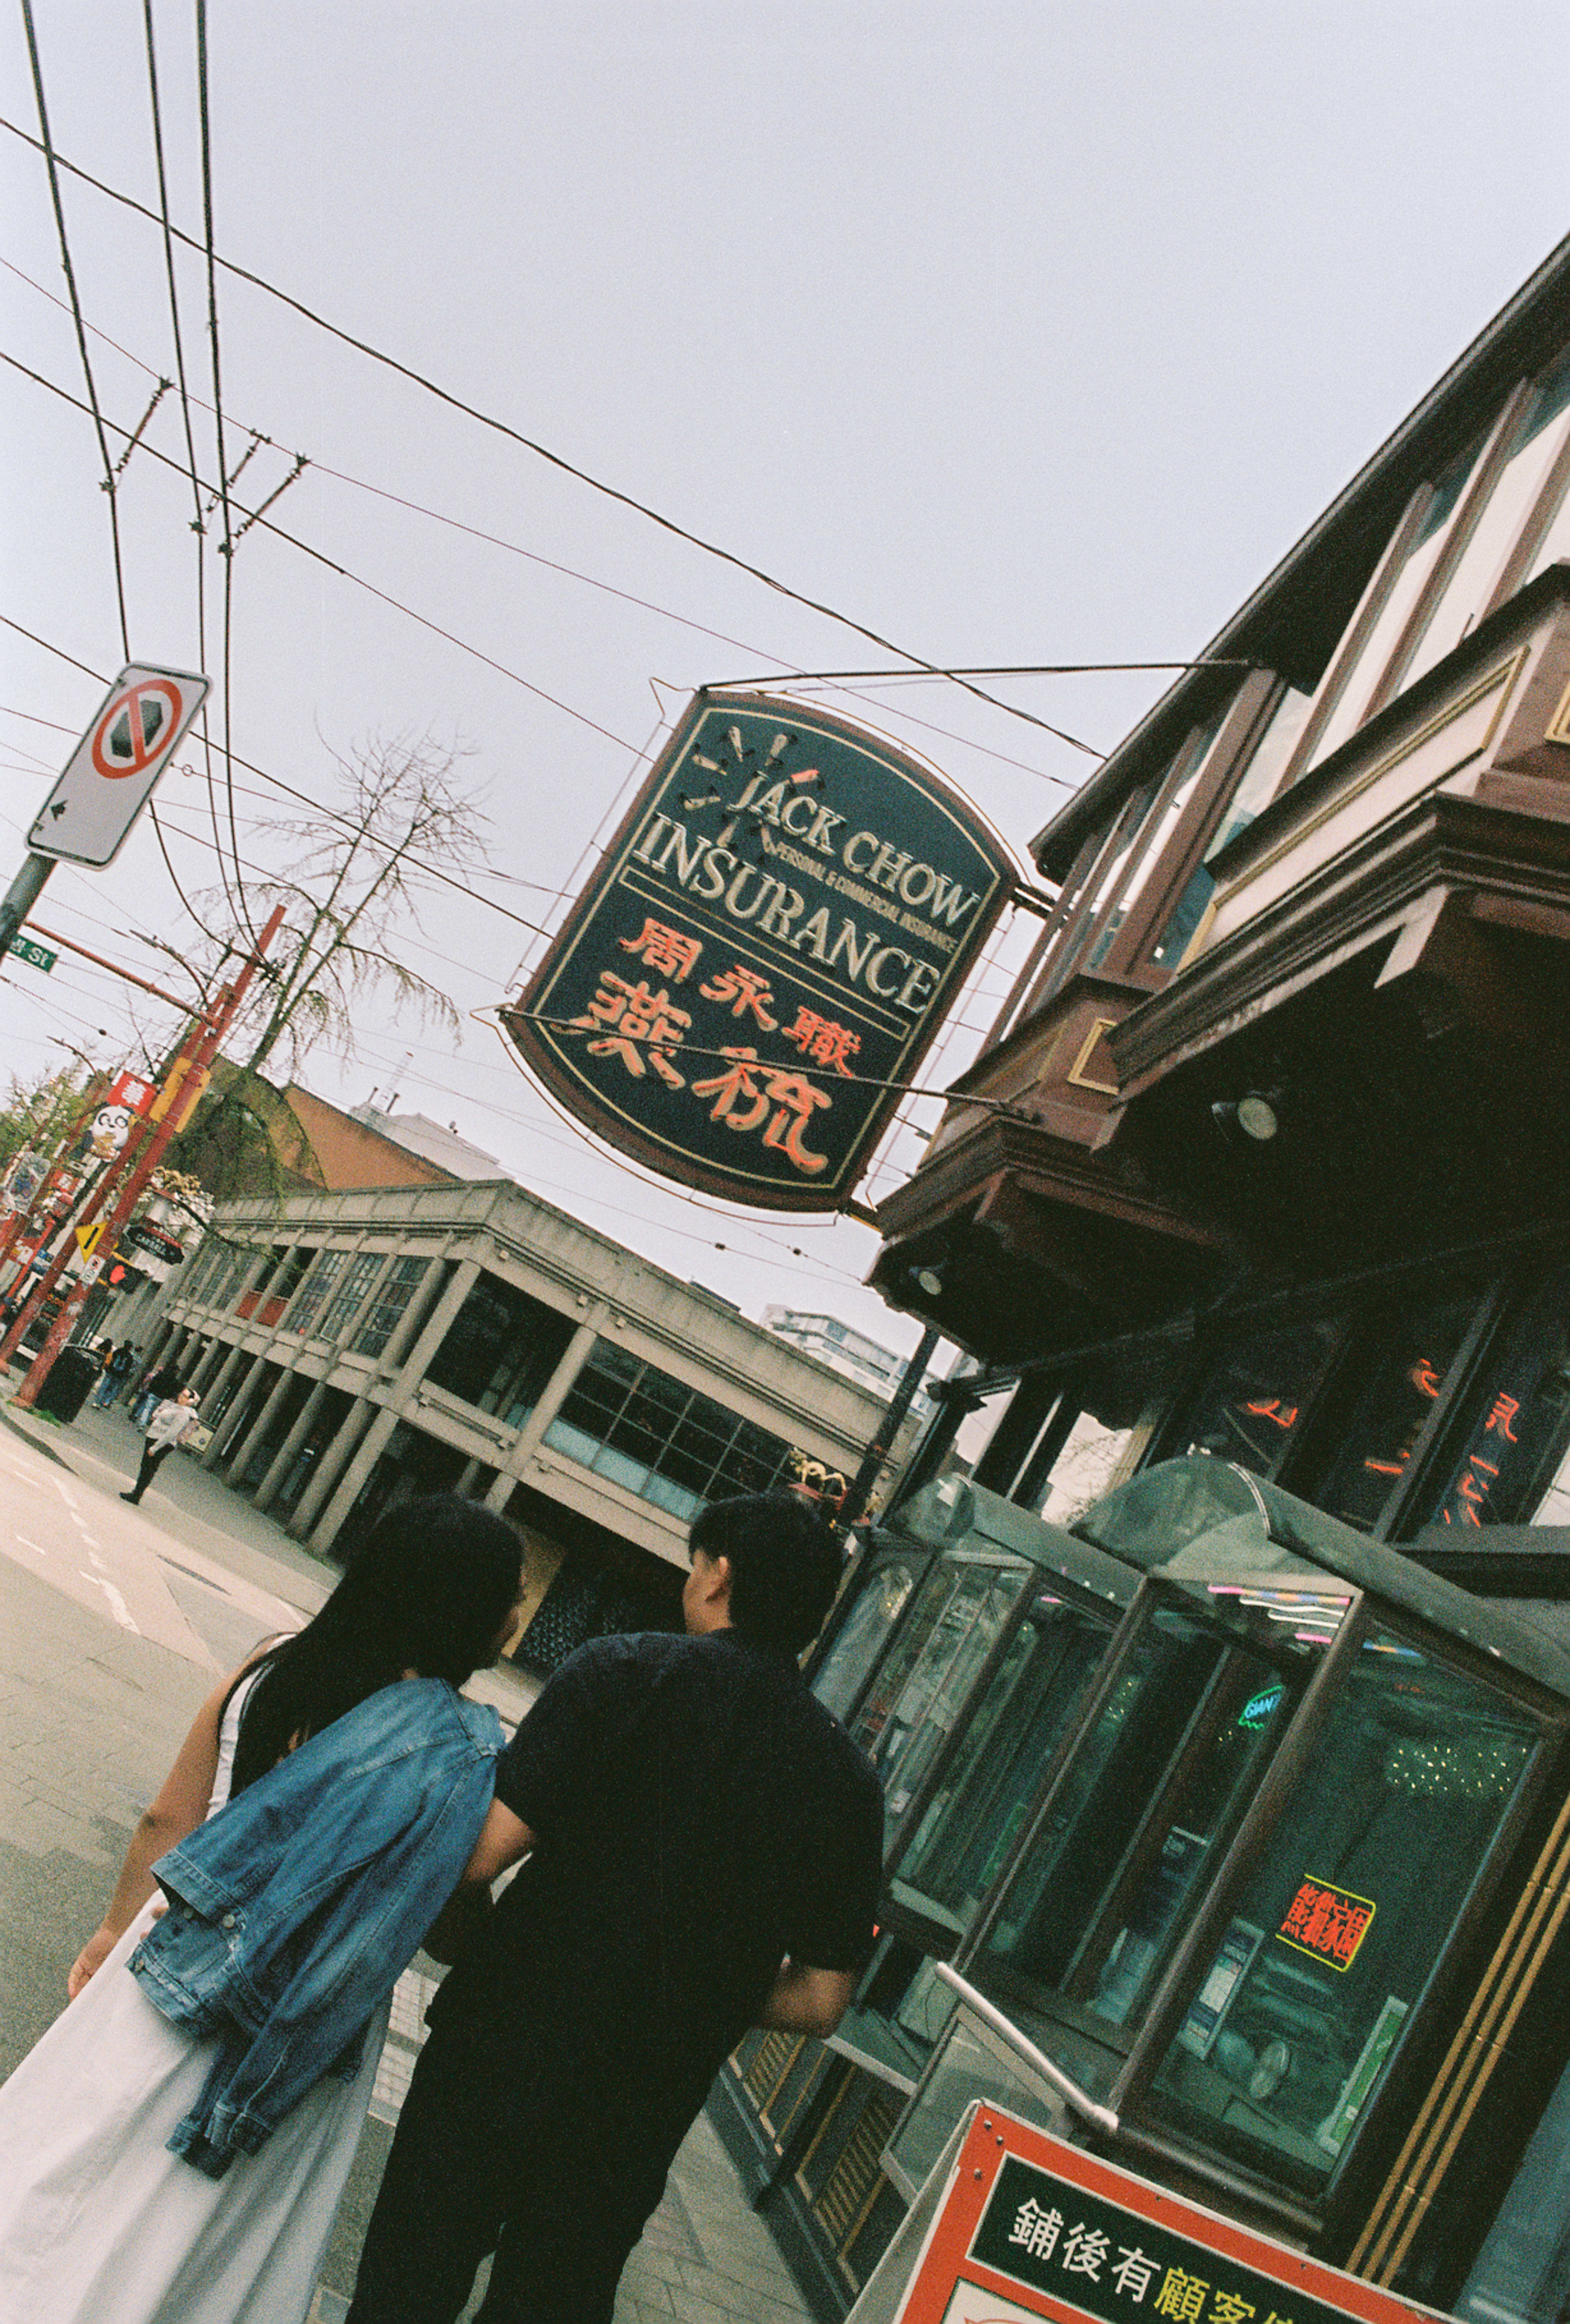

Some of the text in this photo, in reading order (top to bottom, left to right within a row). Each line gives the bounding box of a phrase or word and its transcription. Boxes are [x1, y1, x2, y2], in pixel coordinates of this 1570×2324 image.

[727, 771, 980, 926] JACK CHOW
[775, 841, 958, 954] PERSONAL & COMMERCIAL INSURANCE
[28, 947, 49, 967] St
[632, 812, 941, 1014] INSURANCE
[1008, 2197, 1293, 2324] 鋪後有顧客
